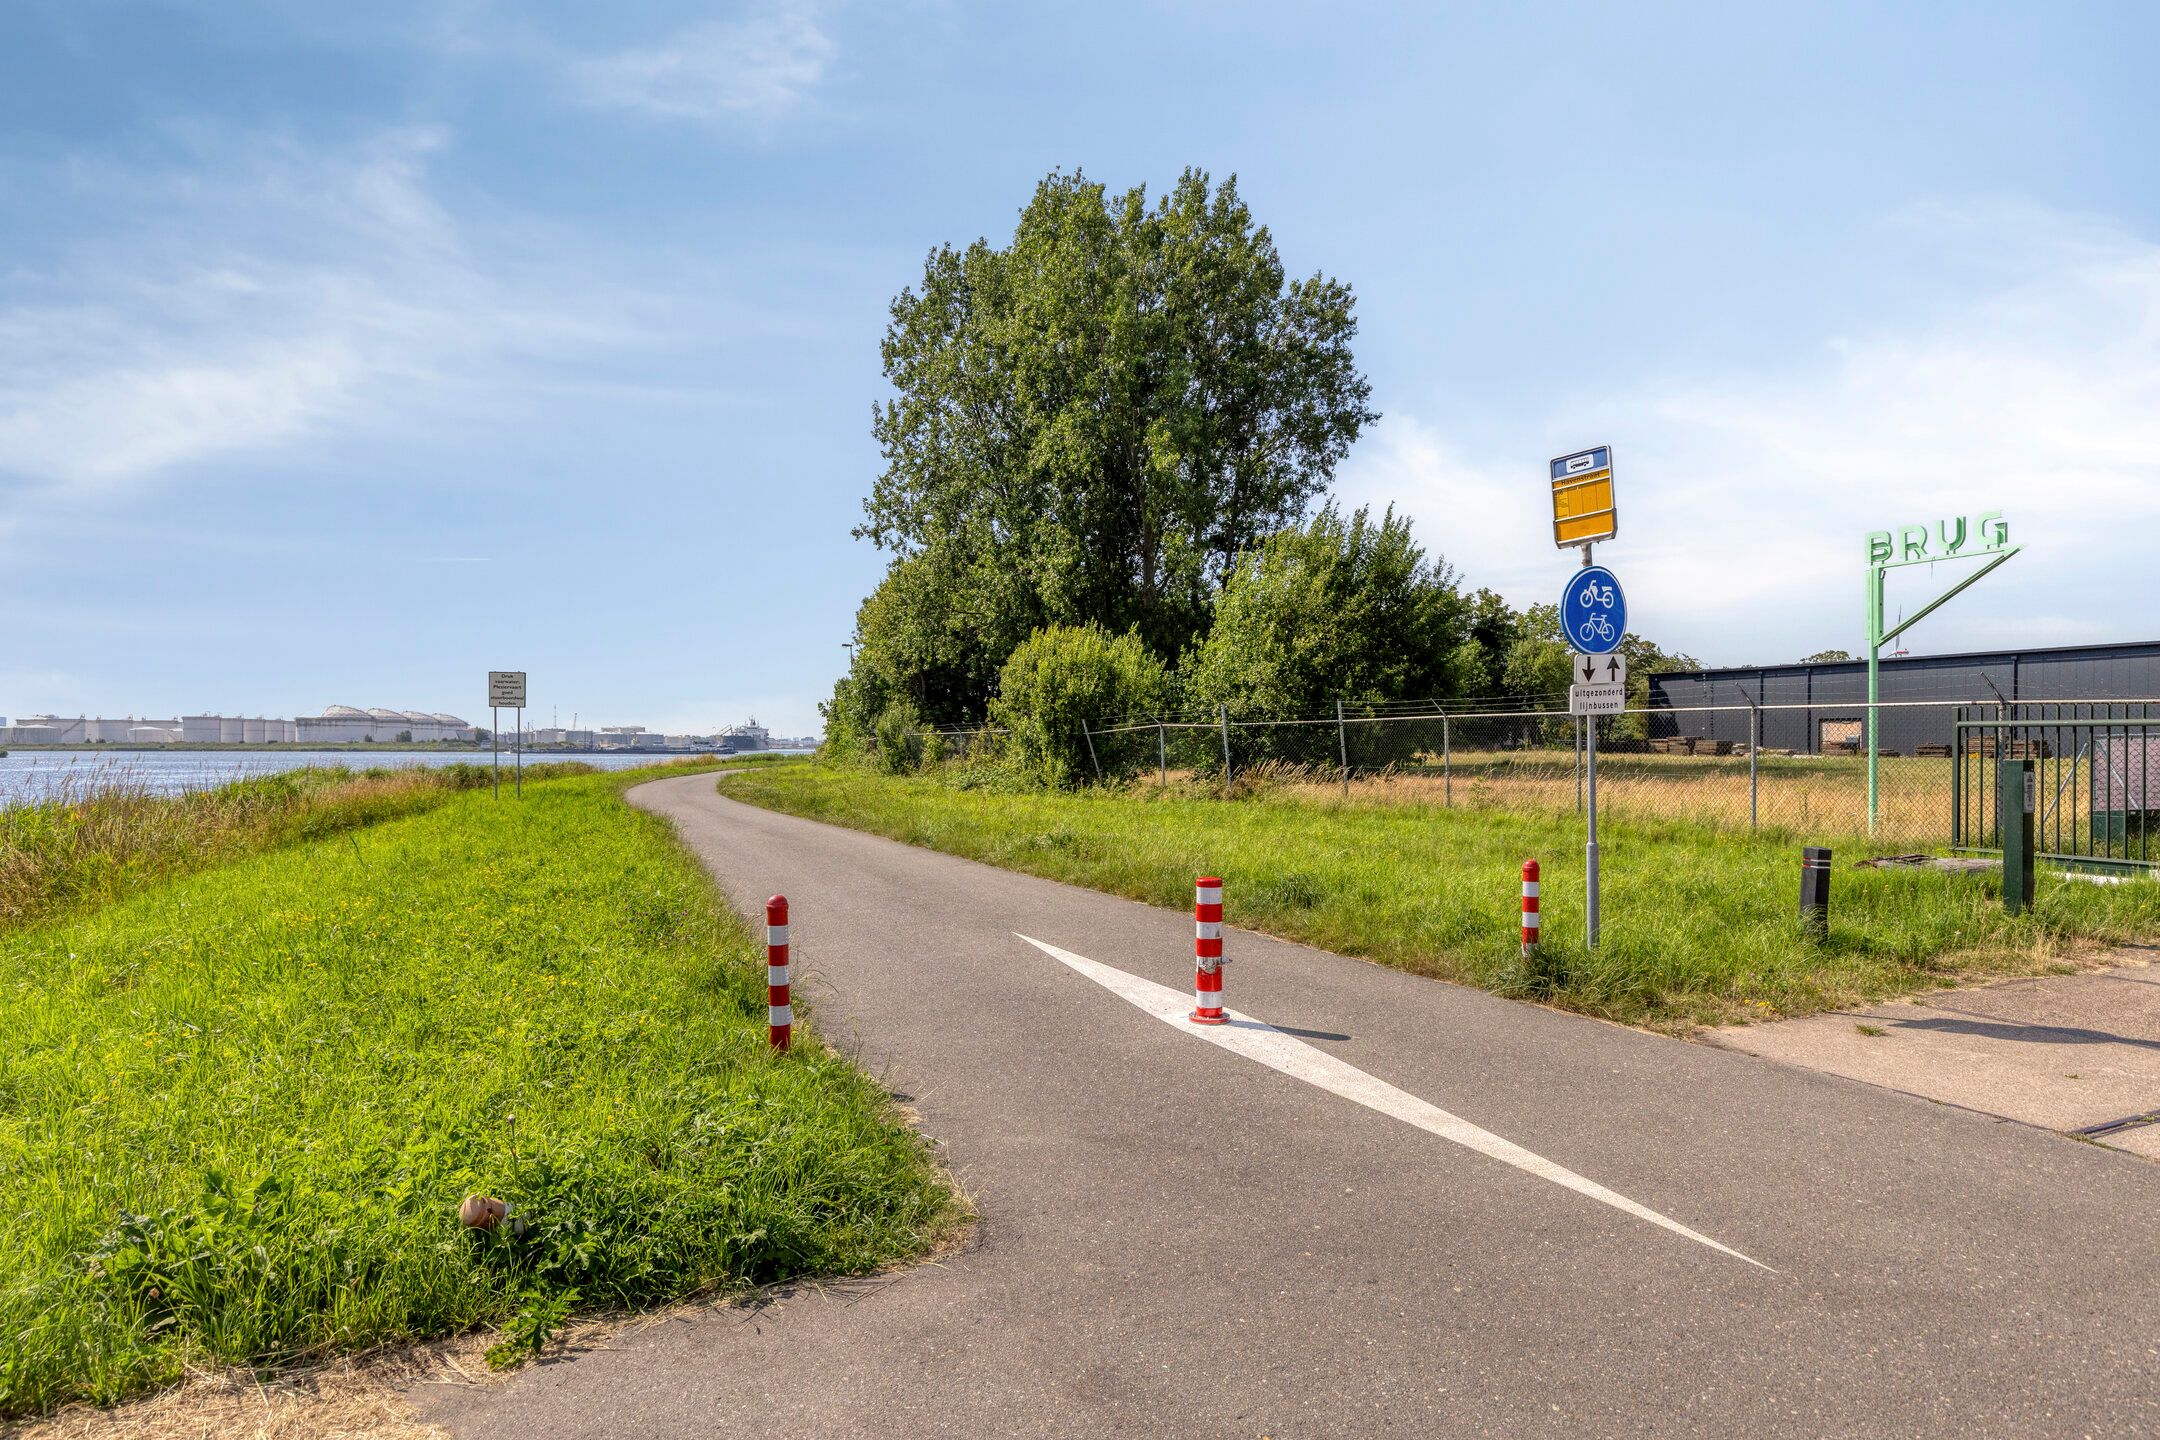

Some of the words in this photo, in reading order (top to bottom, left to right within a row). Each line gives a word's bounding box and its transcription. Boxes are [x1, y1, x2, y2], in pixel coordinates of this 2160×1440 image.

[1561, 471, 1601, 486] Havenstraat
[1864, 510, 2009, 563] BRUG
[1574, 688, 1623, 698] uitgezonderd
[1579, 701, 1619, 711] lijnbussen
